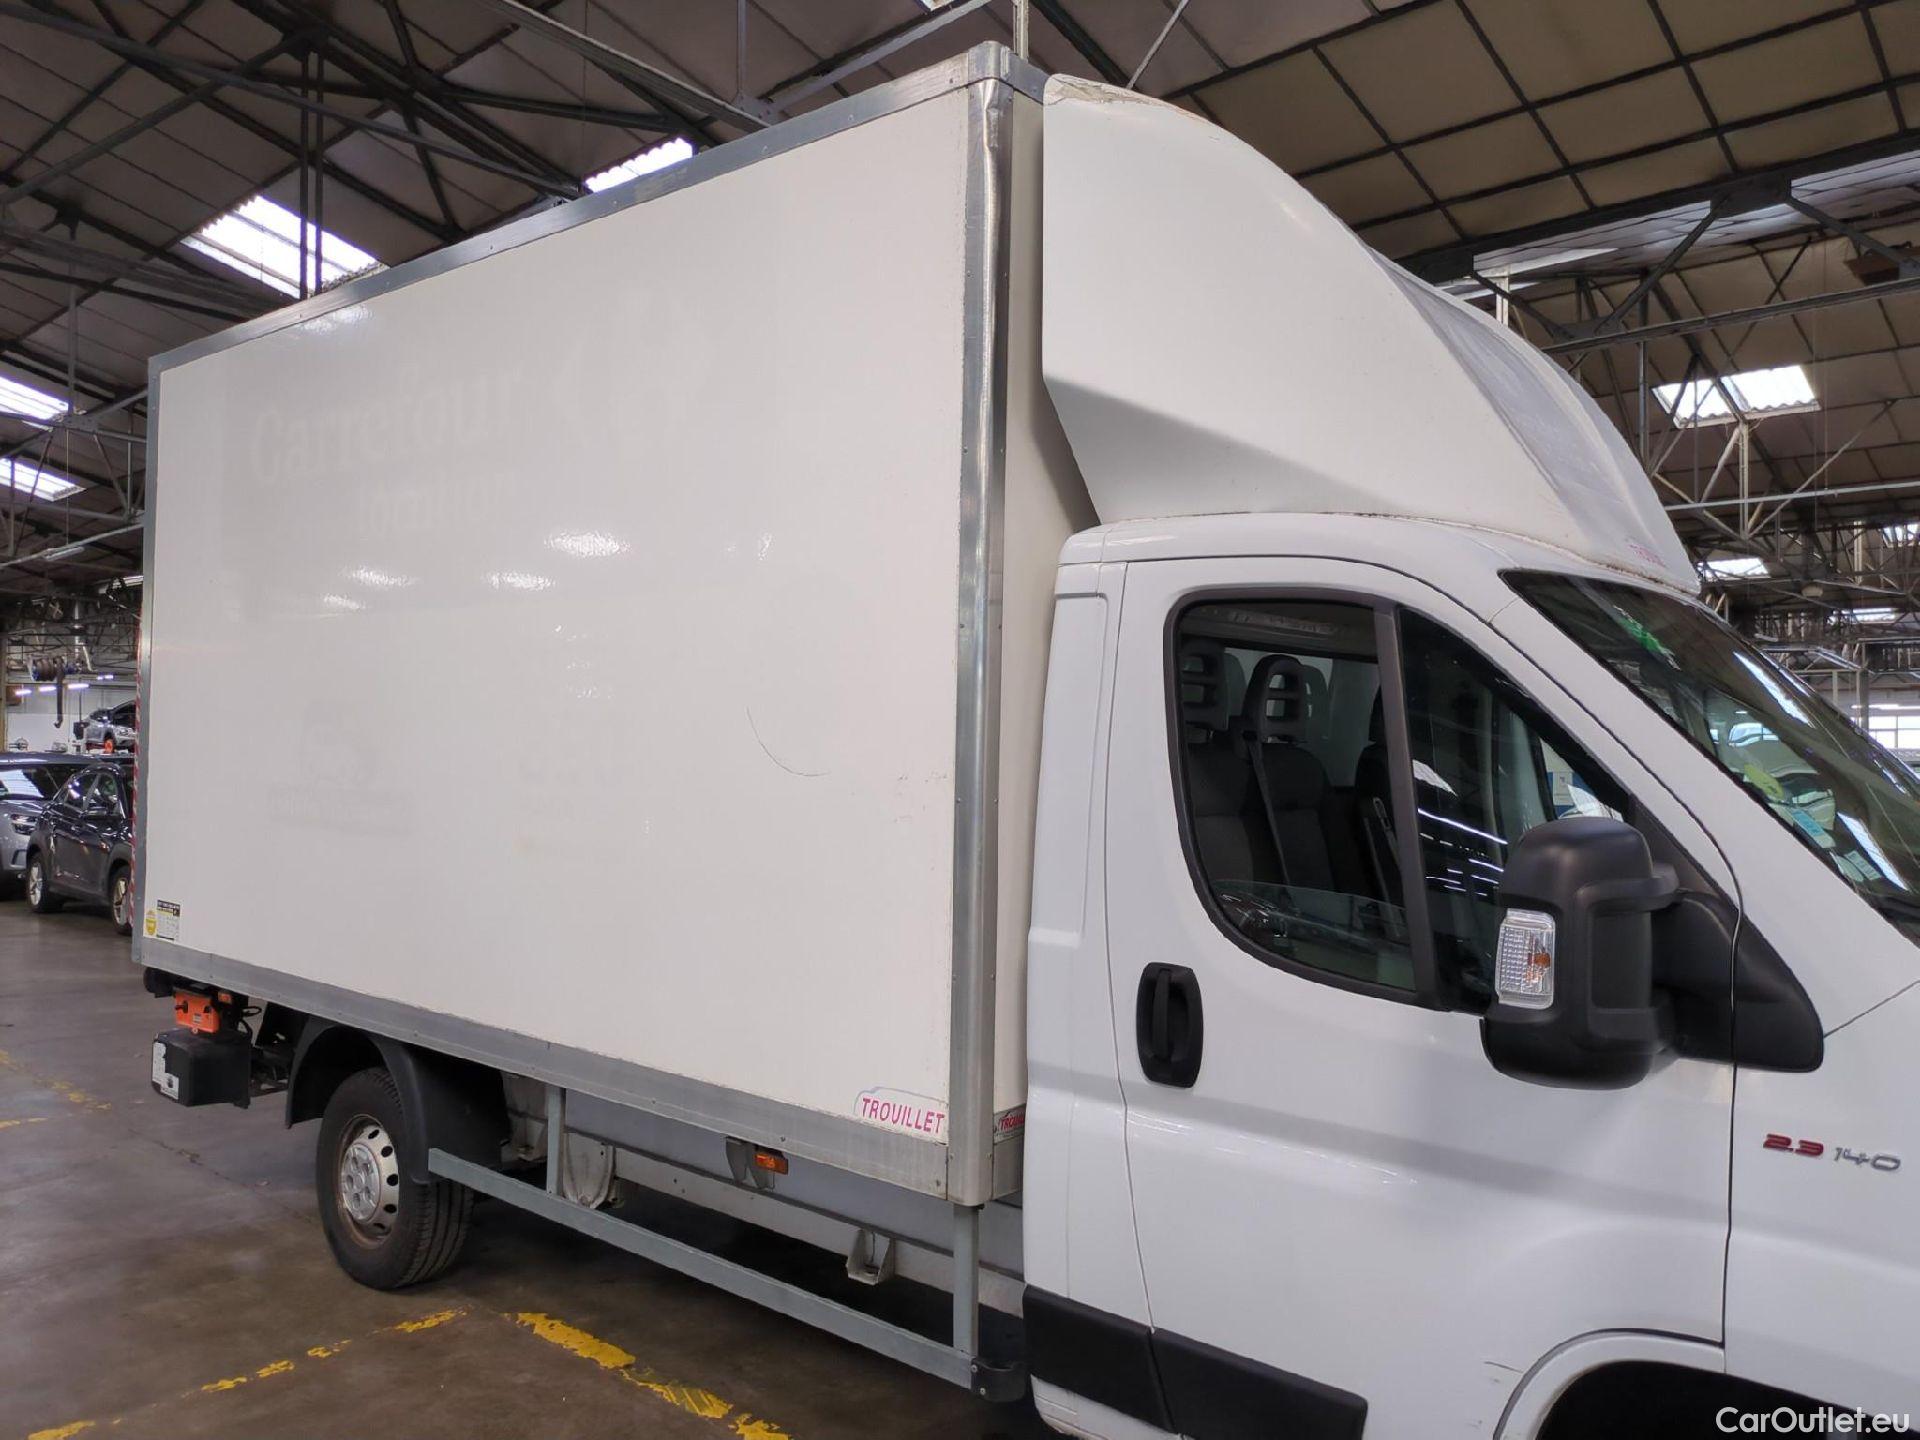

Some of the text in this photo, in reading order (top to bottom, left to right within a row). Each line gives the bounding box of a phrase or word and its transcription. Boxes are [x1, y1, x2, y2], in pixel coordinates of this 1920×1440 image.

[862, 1097, 945, 1134] TROUILLET
[1763, 1133, 1901, 1172] 2.3 140
